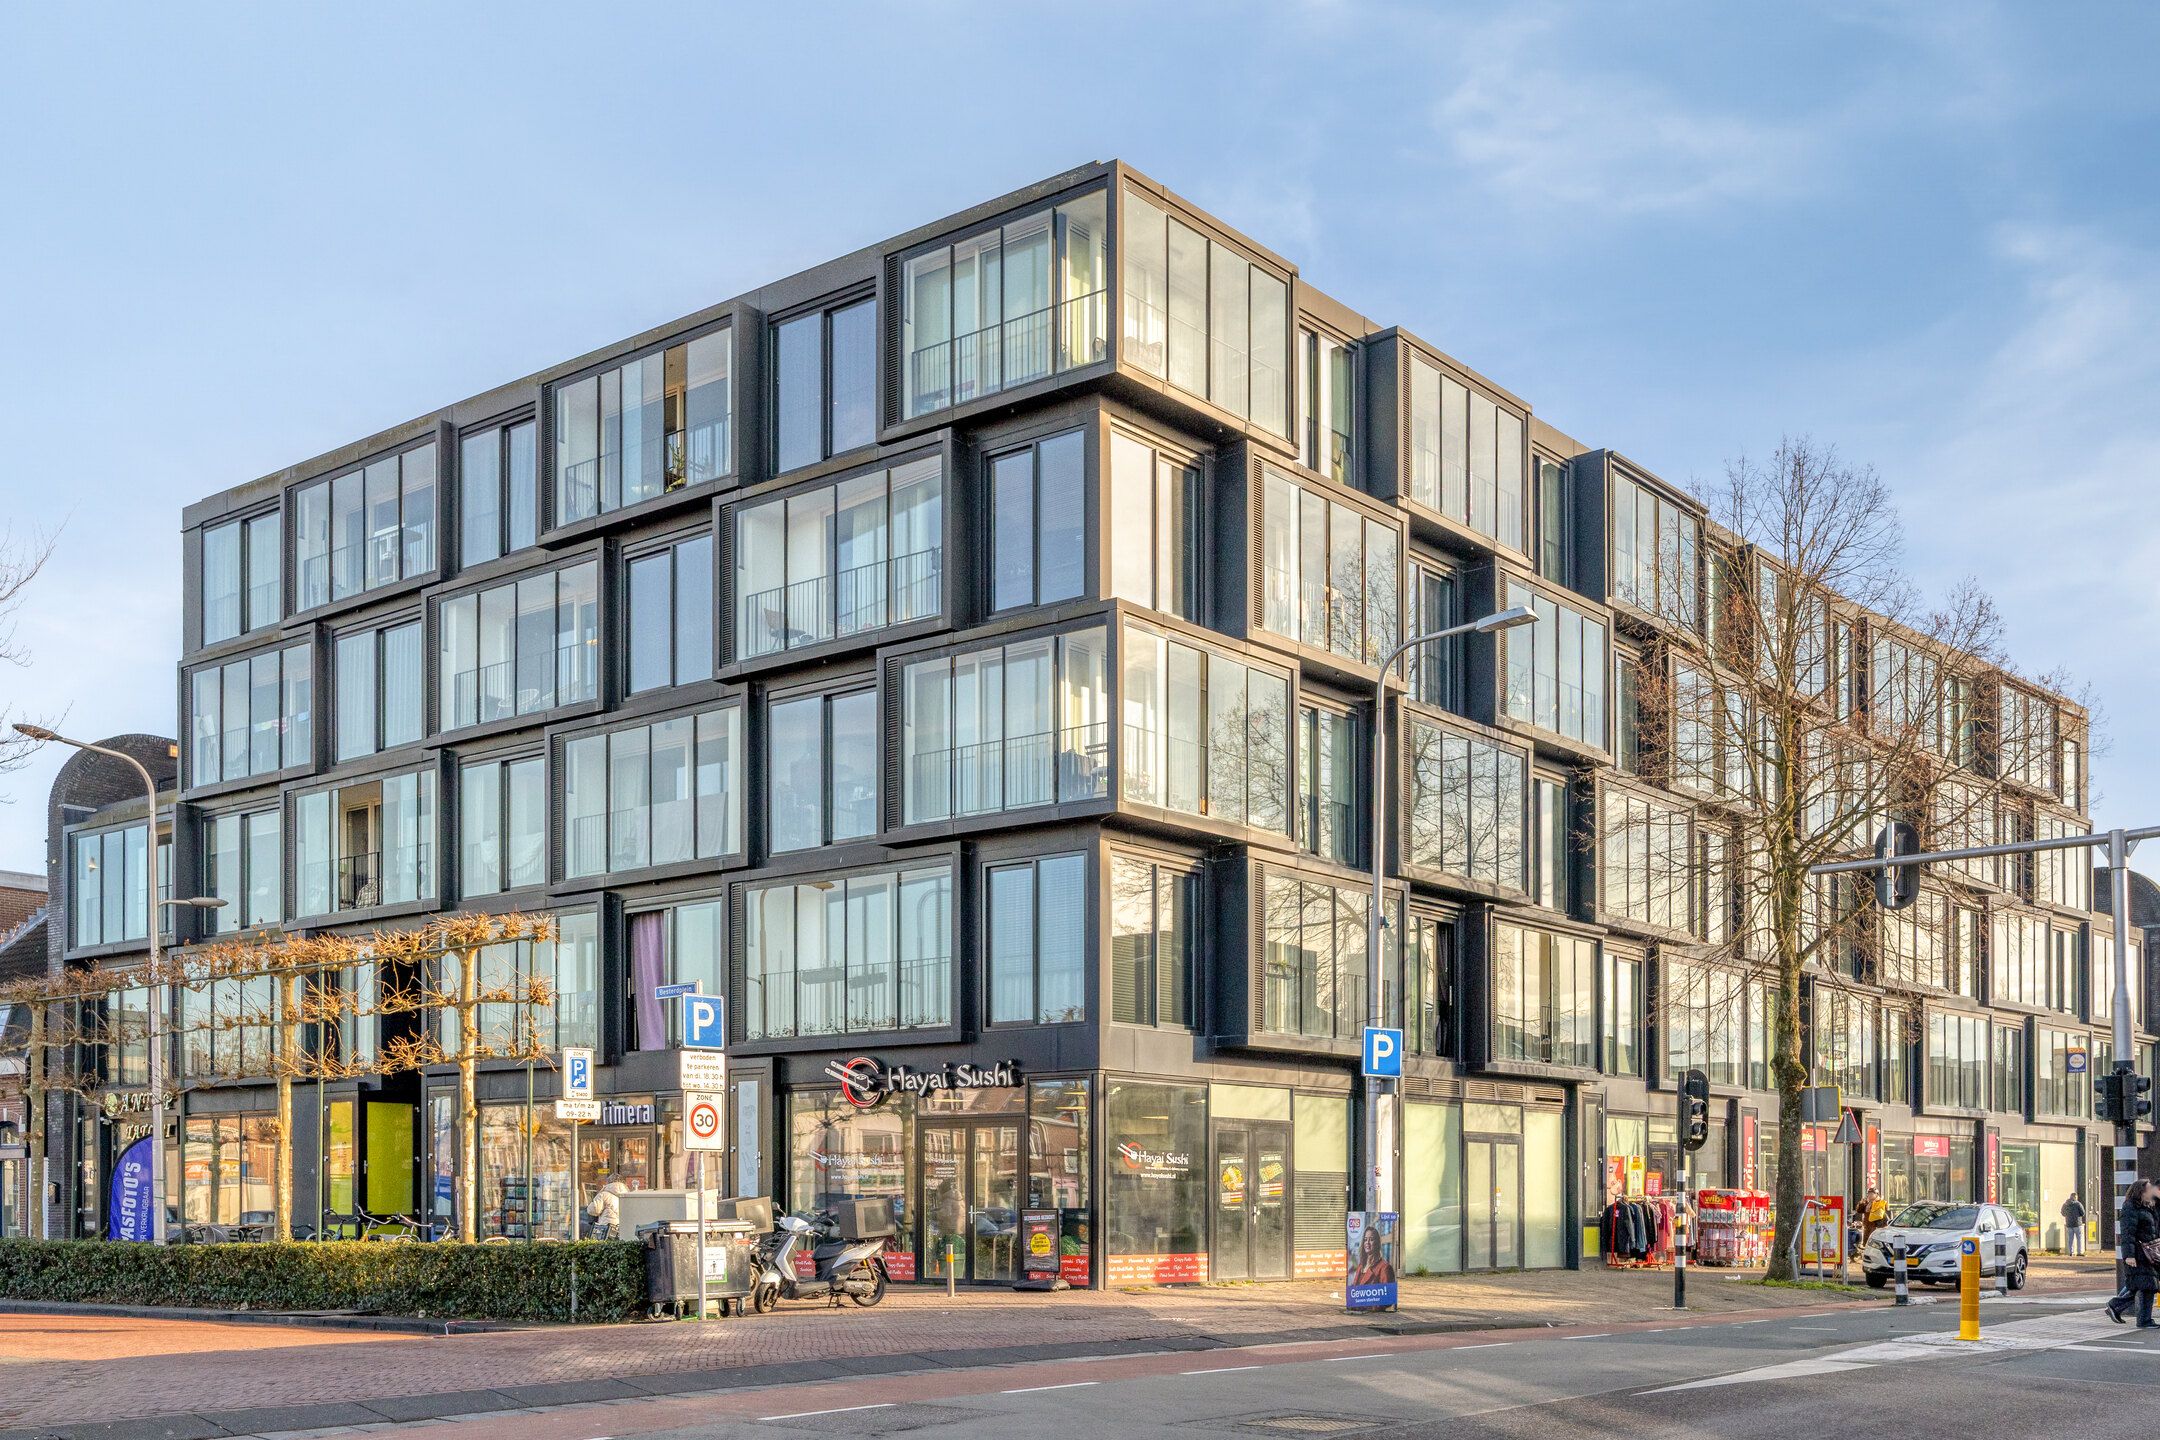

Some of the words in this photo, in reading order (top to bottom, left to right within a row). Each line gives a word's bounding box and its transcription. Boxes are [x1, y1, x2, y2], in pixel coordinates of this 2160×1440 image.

[693, 1002, 715, 1040] P
[1373, 1034, 1393, 1070] P
[888, 1063, 949, 1097] Hayai
[956, 1060, 1013, 1087] Sushi
[119, 1092, 173, 1114] ANTP
[595, 1101, 652, 1125] rimera
[696, 1114, 714, 1127] 30
[1139, 1151, 1165, 1166] Hayai
[1166, 1153, 1189, 1165] Sushi
[1351, 1286, 1387, 1298] Gewoon!
